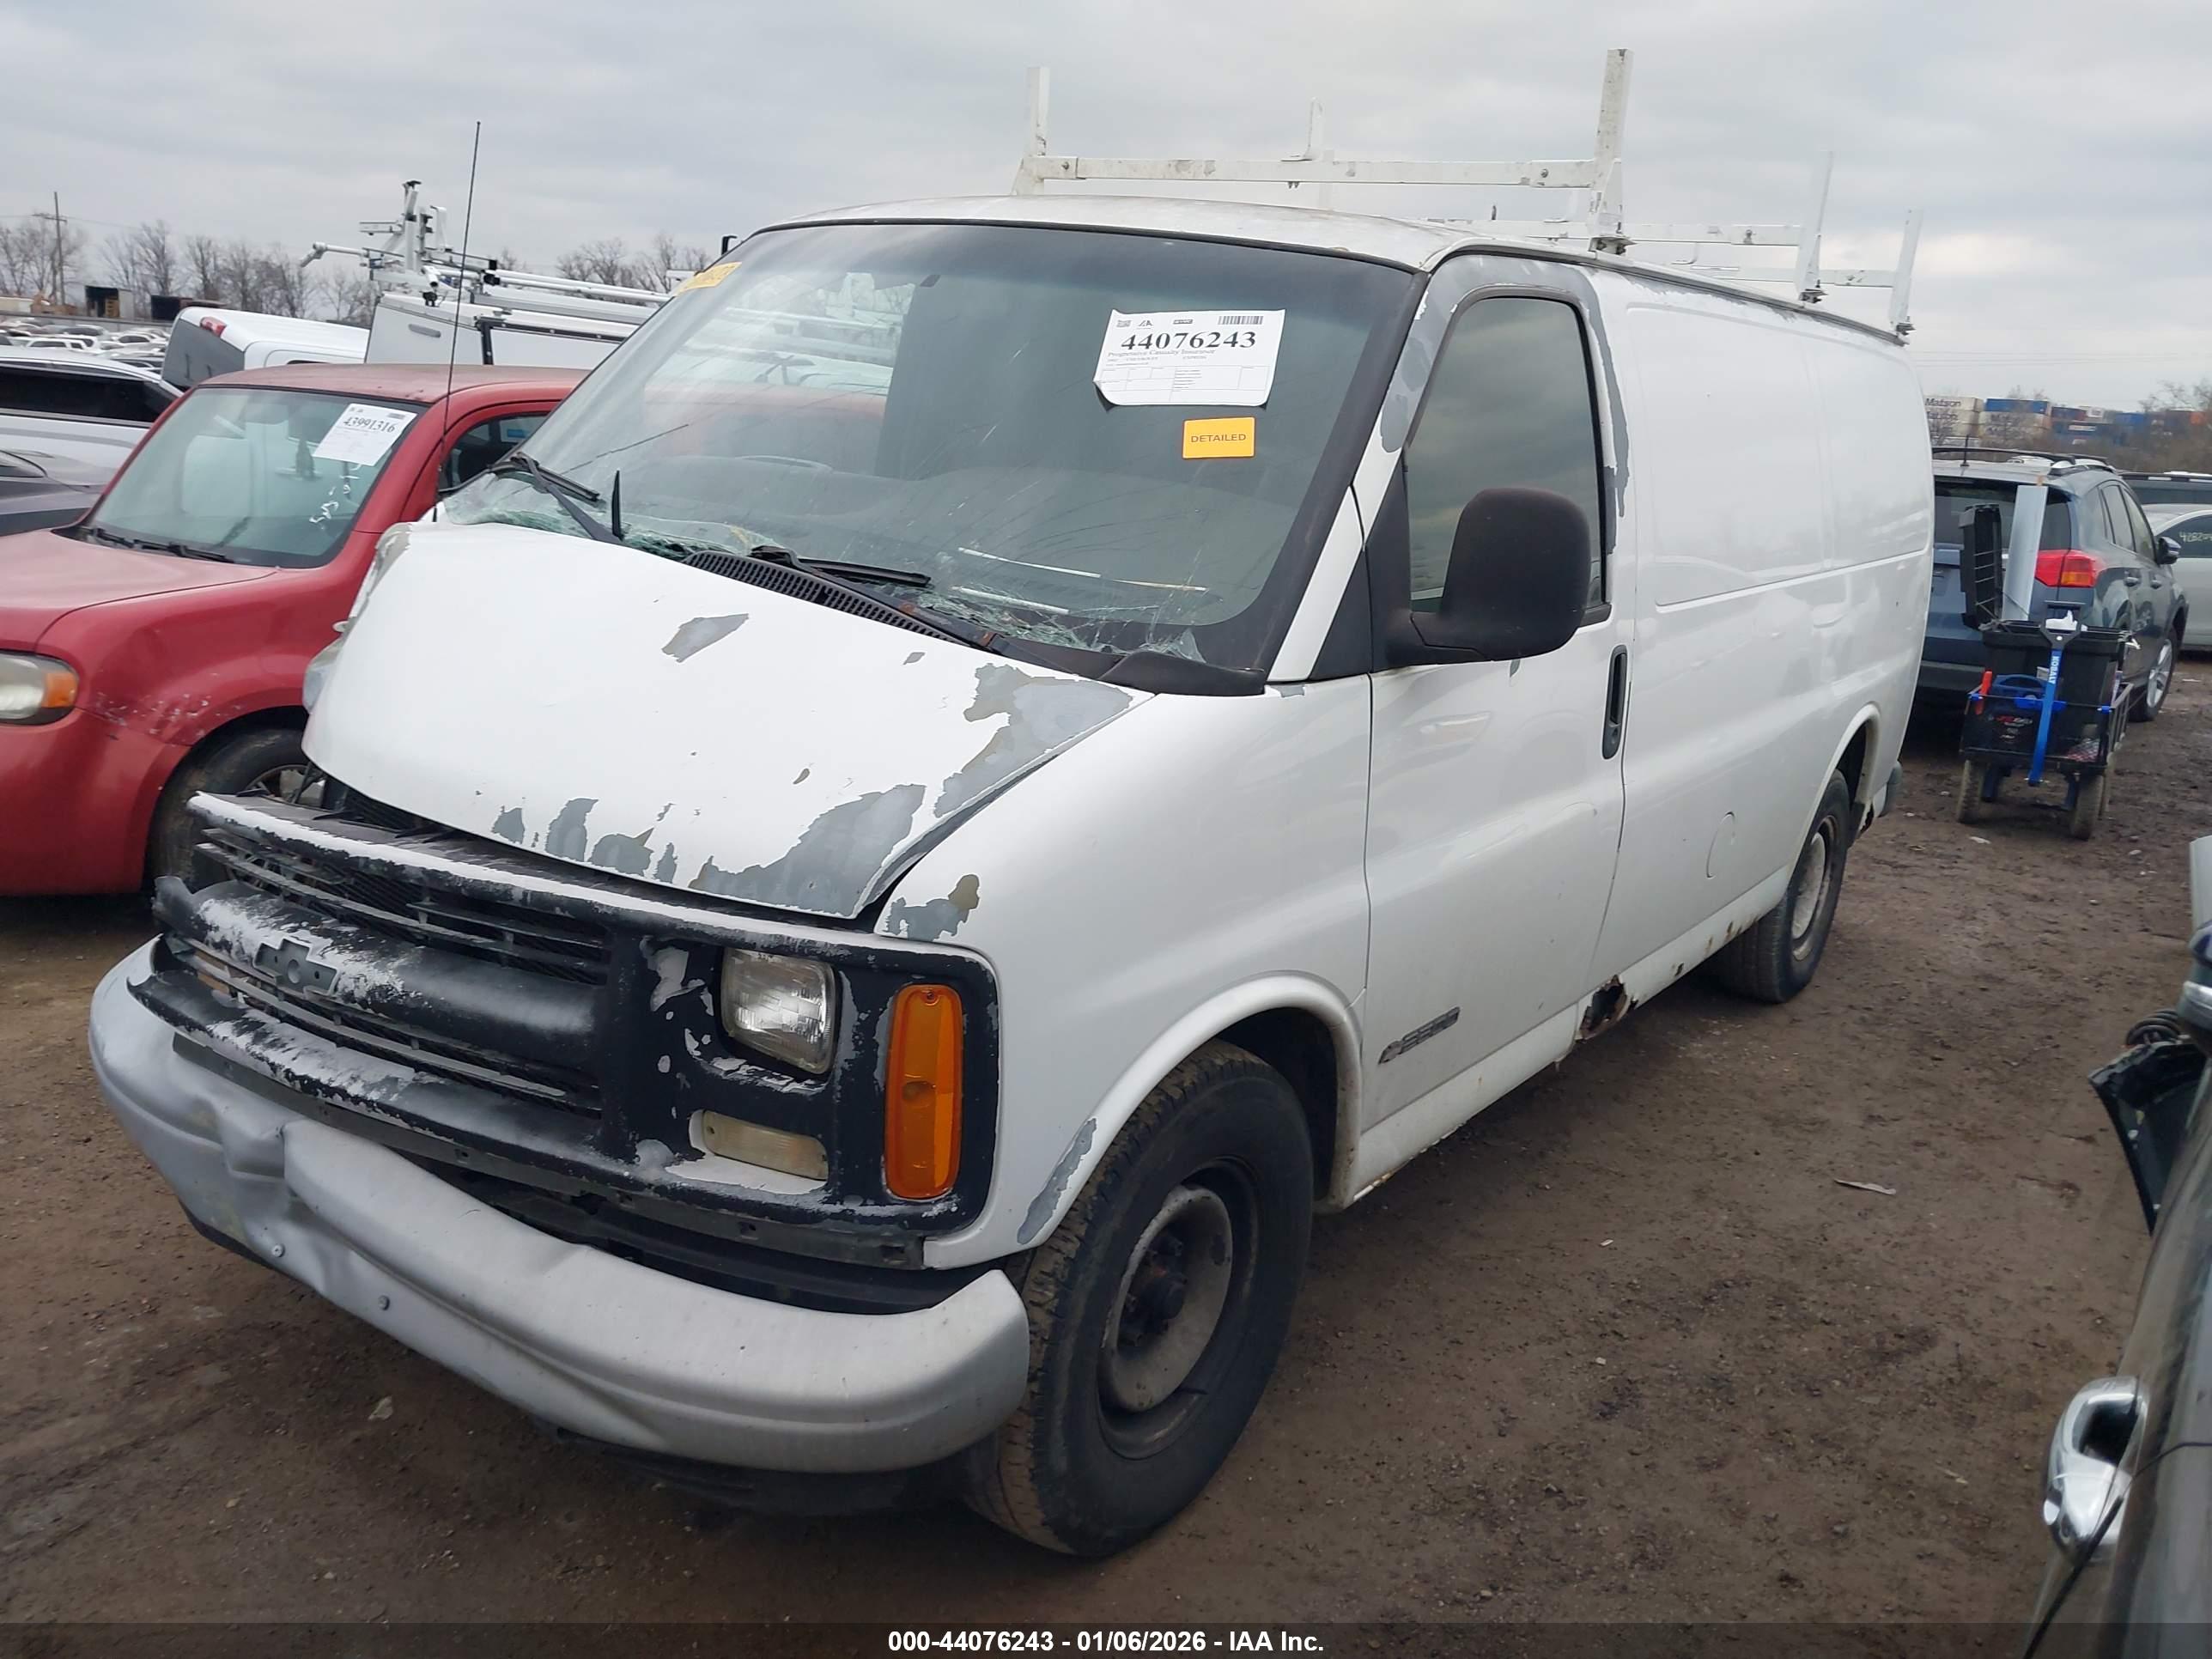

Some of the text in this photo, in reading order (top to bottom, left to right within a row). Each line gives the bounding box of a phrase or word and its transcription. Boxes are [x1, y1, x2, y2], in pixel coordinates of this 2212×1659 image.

[1121, 331, 1256, 349] 44076243
[1924, 398, 1961, 407] Matson
[343, 416, 396, 433] 43991316
[1190, 433, 1247, 444] DETAILED
